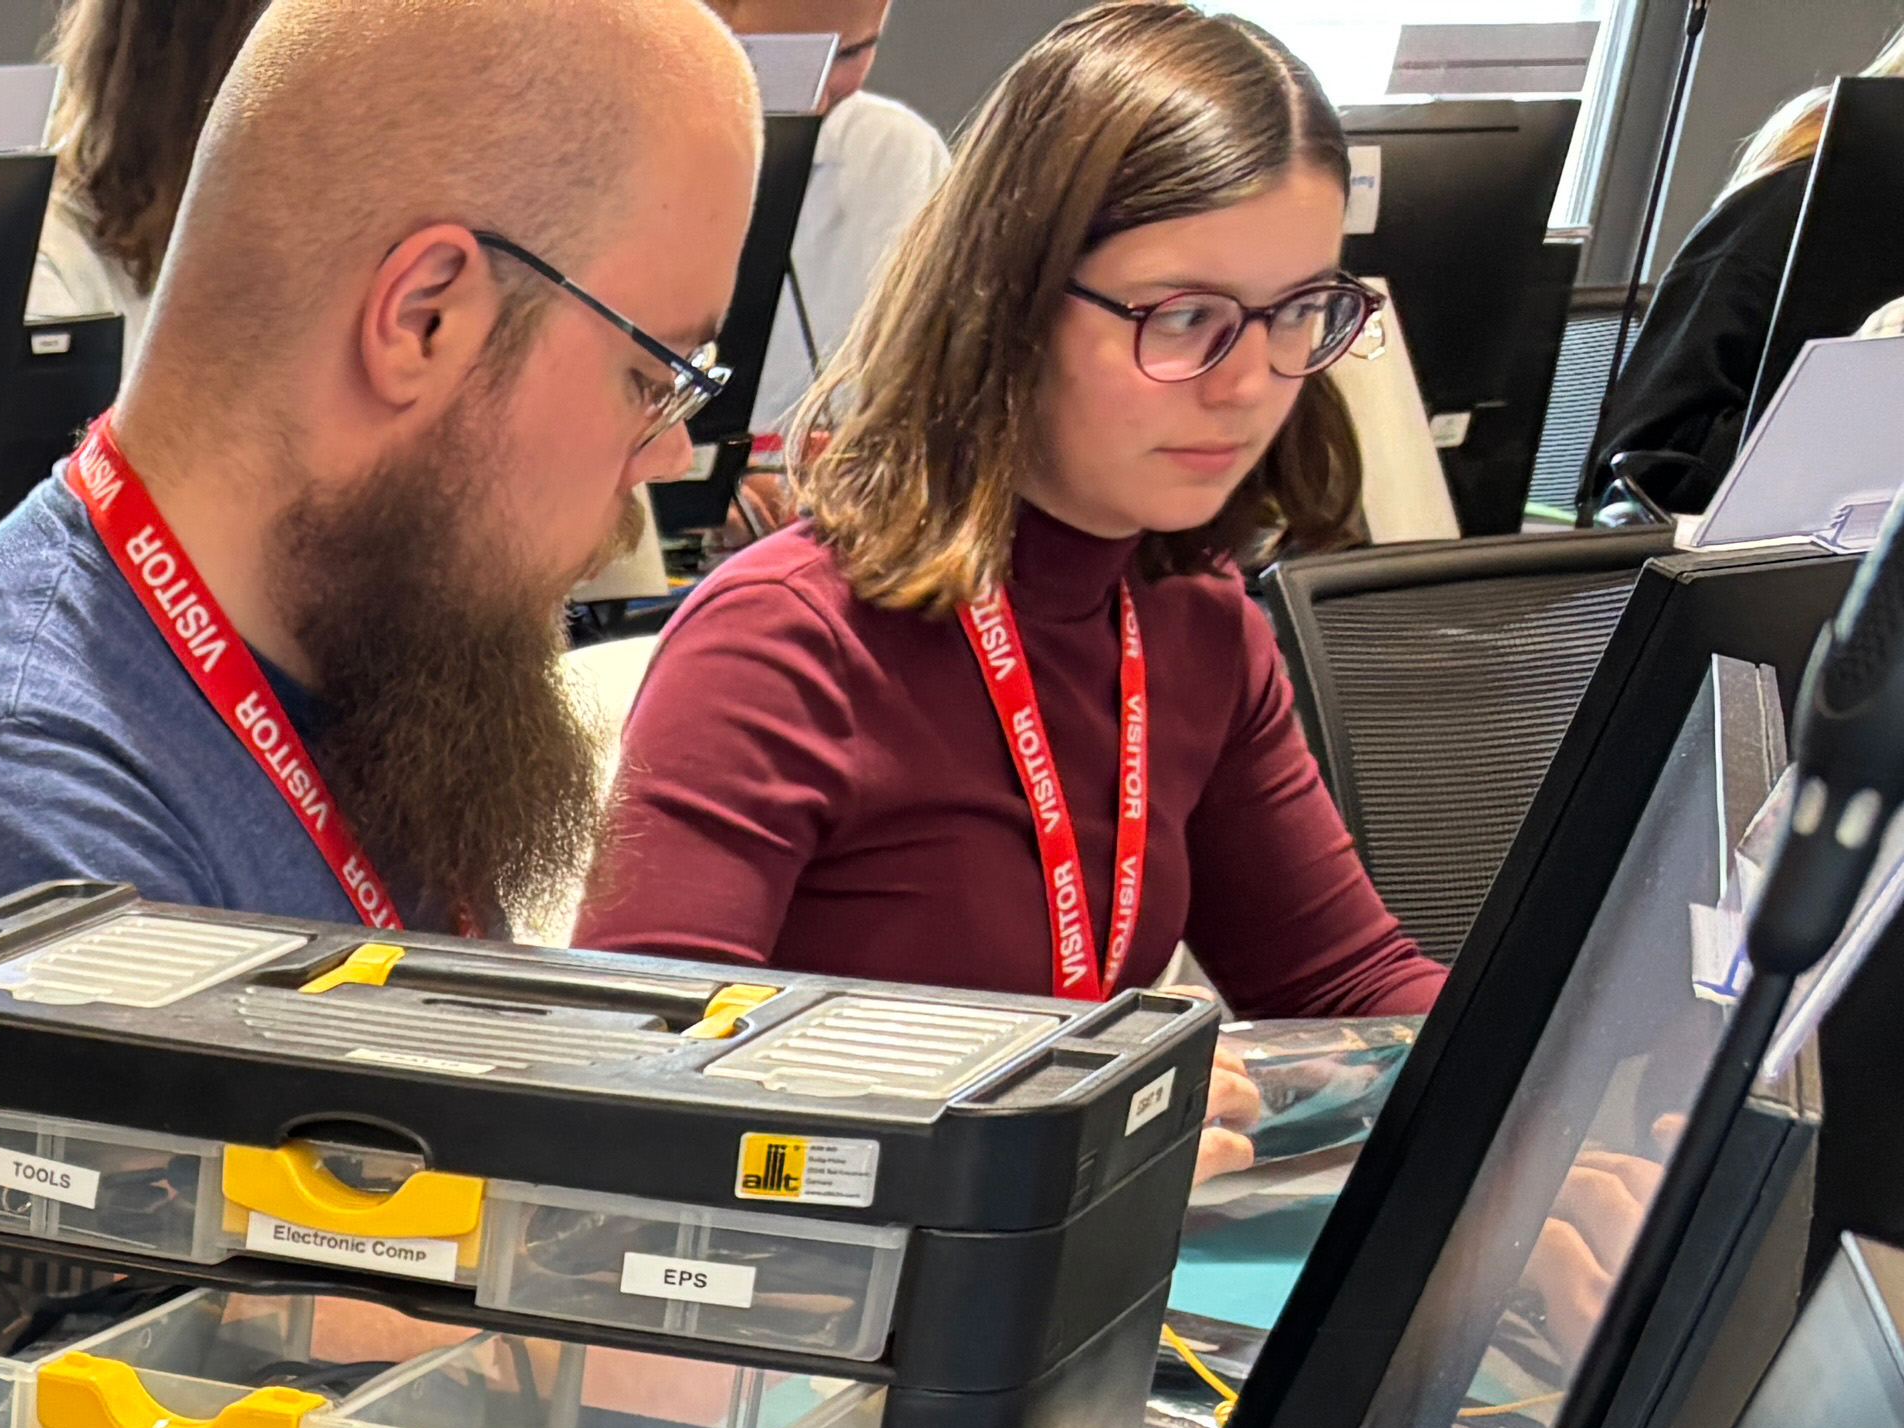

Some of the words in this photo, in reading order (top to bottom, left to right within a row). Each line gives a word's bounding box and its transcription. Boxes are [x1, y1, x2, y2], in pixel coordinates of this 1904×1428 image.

[125, 525, 230, 673] VISITOR
[235, 690, 329, 832] VISITOR
[1013, 705, 1059, 833] VISITOR
[1124, 694, 1143, 820] VISITOR
[1053, 860, 1088, 988] VISITOR
[12, 1159, 73, 1190] TOOLS
[272, 1222, 367, 1256] Electronic
[370, 1236, 428, 1263] Comp
[663, 1268, 709, 1290] EPS
